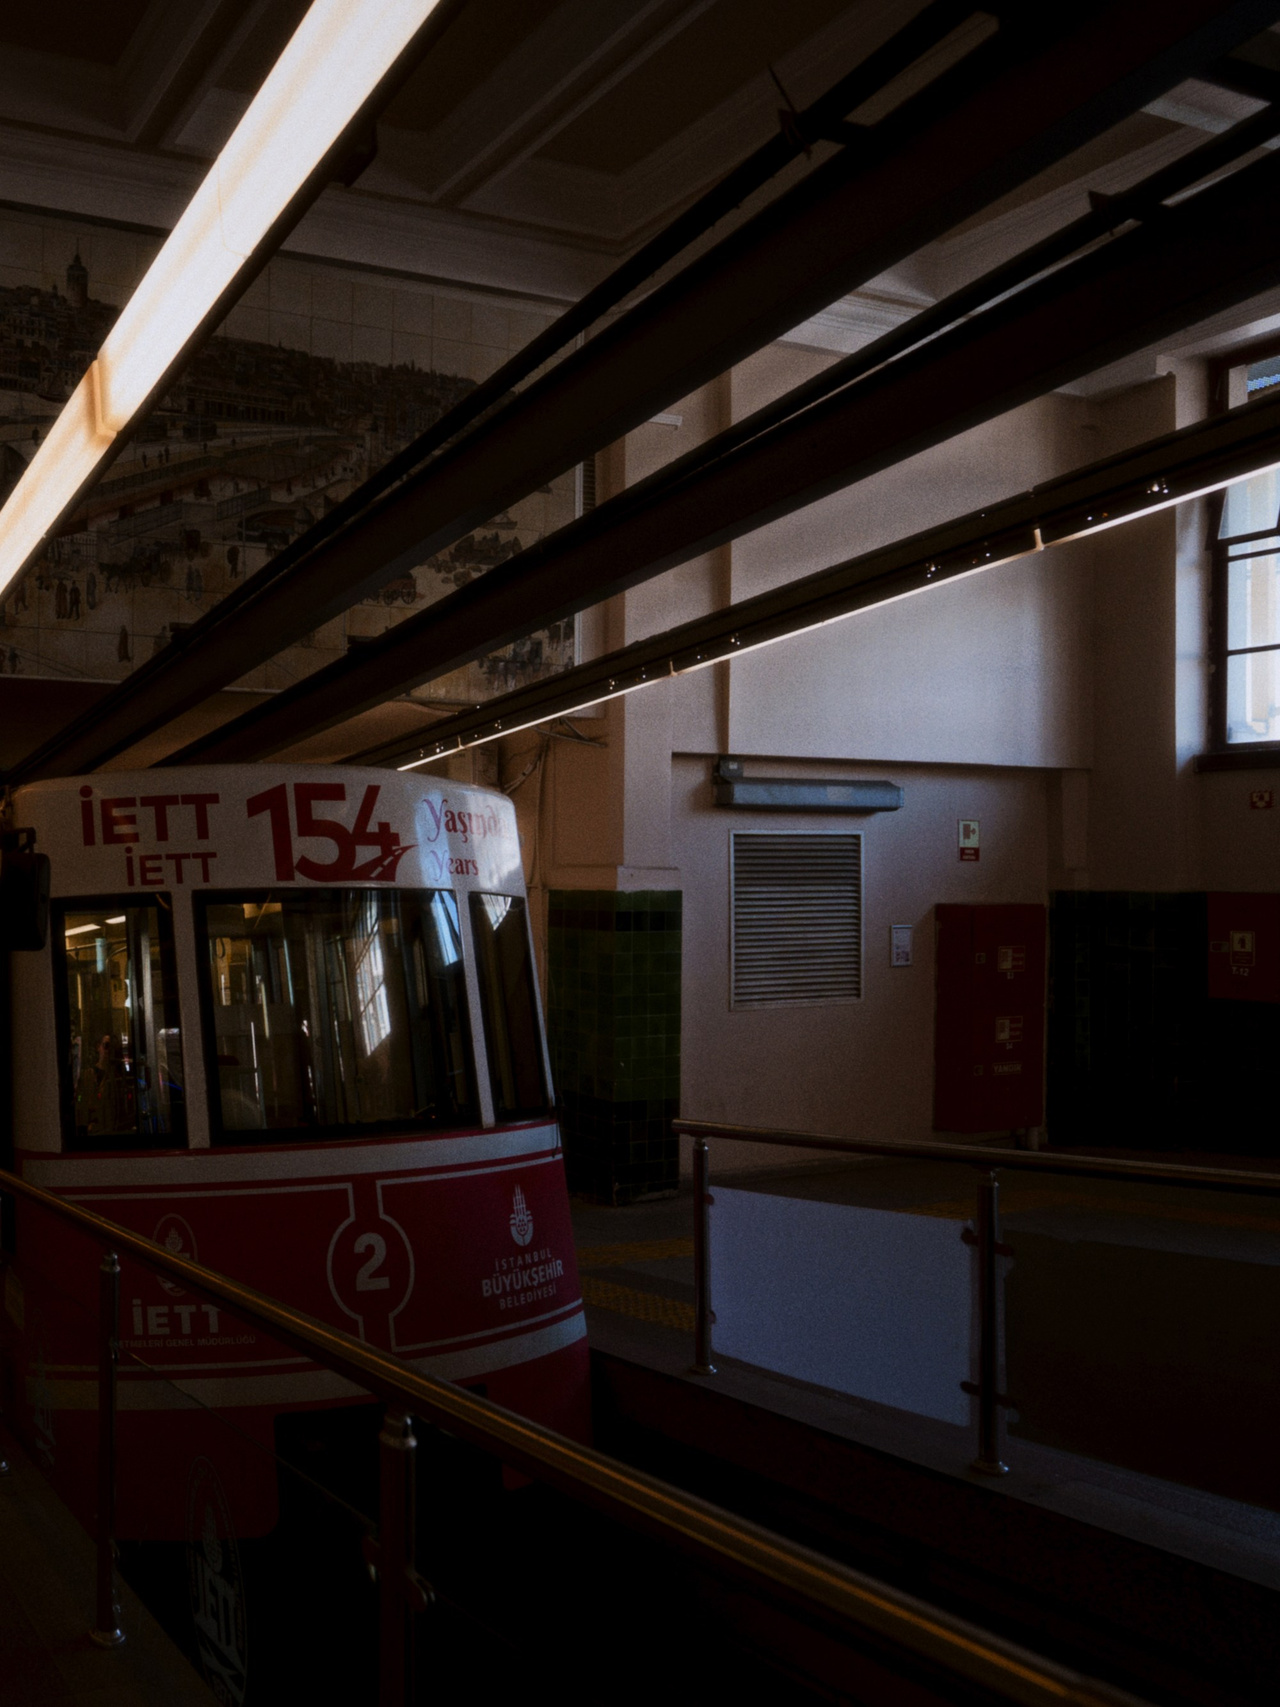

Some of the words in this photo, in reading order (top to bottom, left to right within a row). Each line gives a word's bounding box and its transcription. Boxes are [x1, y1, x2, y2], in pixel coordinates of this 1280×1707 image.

[79, 785, 220, 846] İETT
[246, 782, 404, 883] 154
[420, 798, 508, 843] Yaşınd
[124, 846, 217, 886] İETT
[429, 850, 479, 882] Years
[353, 1232, 390, 1292] 2
[481, 1257, 564, 1298] BÜYÜKŞEHİR
[494, 1247, 552, 1272] İSTANBUL
[498, 1281, 557, 1311] BELEDİYESİ
[131, 1298, 222, 1336] İETT
[165, 1339, 195, 1348] GENEL
[197, 1335, 257, 1347] MÜDÜRLÜĞÜ
